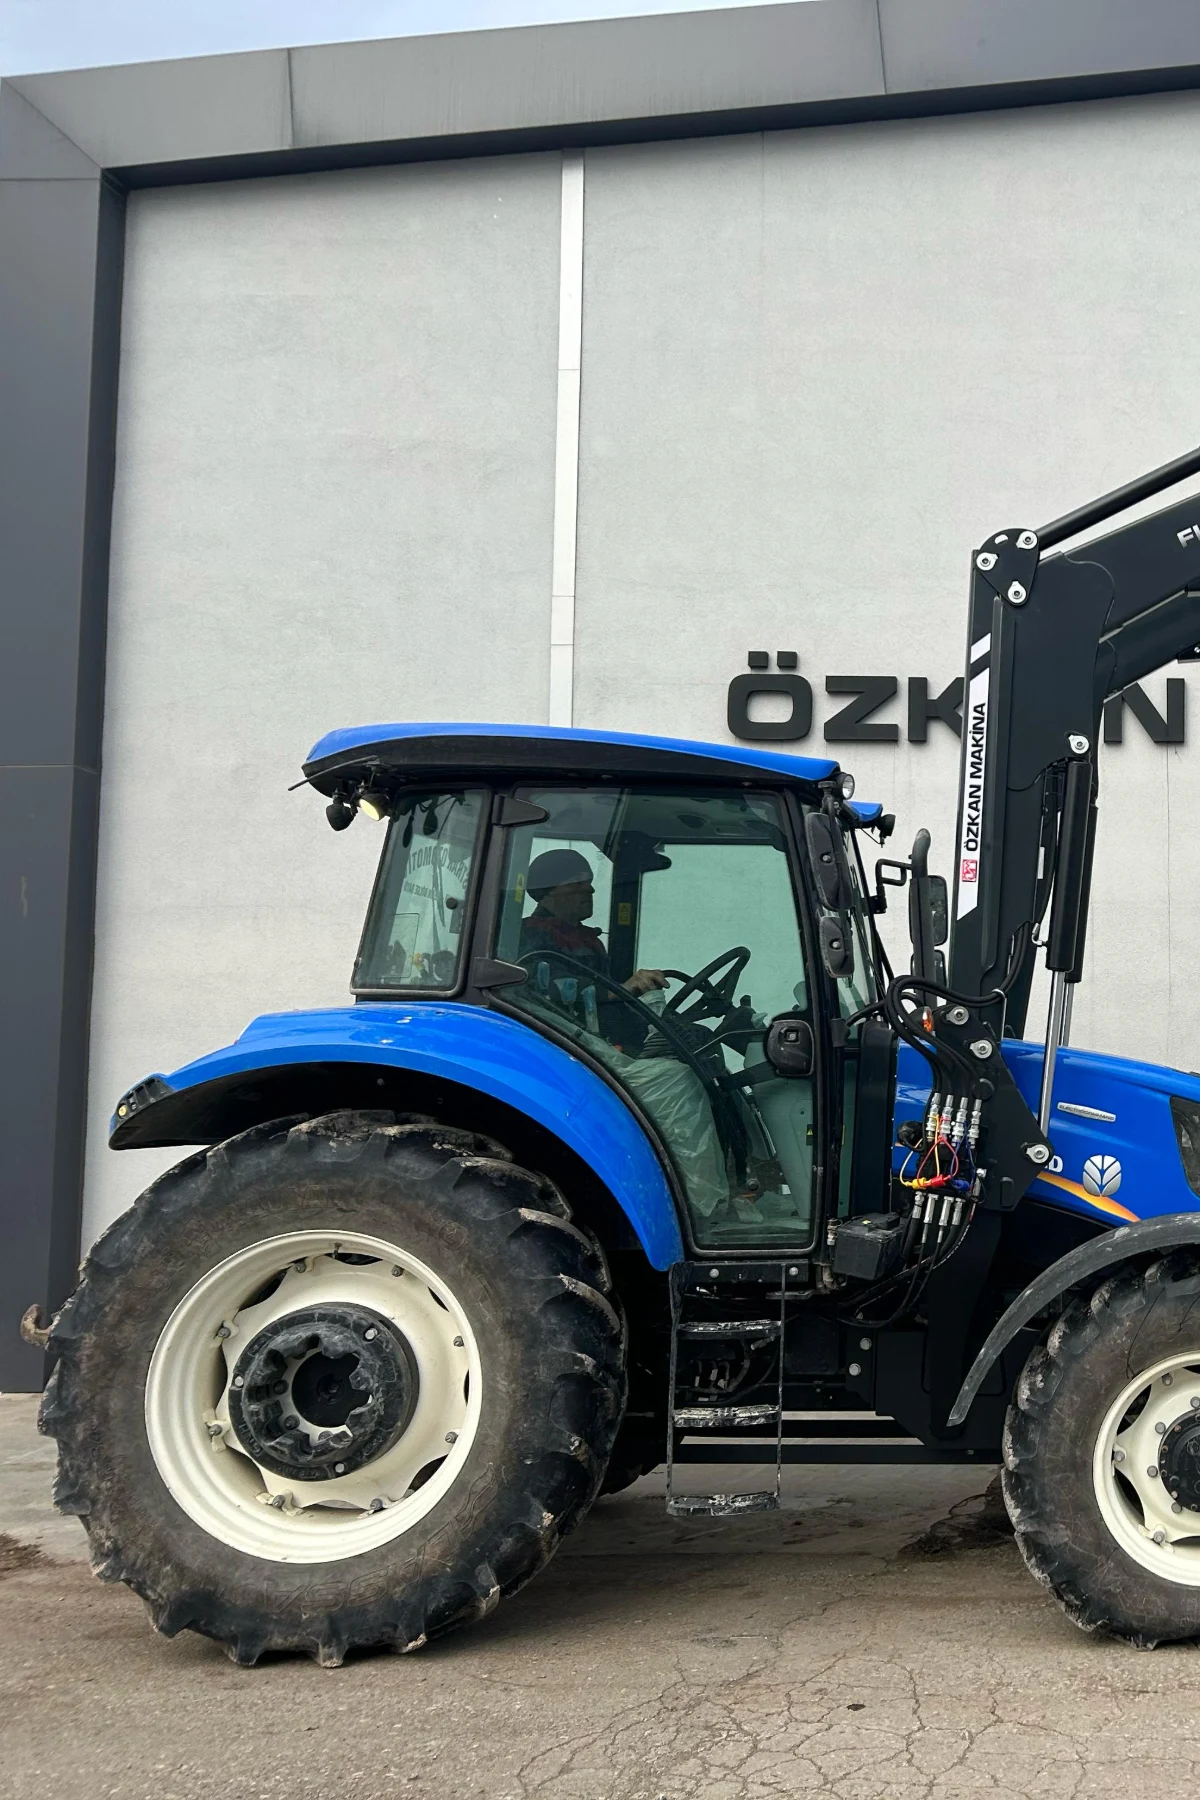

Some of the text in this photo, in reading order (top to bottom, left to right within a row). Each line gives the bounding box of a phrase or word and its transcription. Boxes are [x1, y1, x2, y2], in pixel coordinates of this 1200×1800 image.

[728, 651, 1185, 743] ÖZKN
[968, 702, 987, 779] MAKİNA
[964, 784, 983, 852] ÖZKAN
